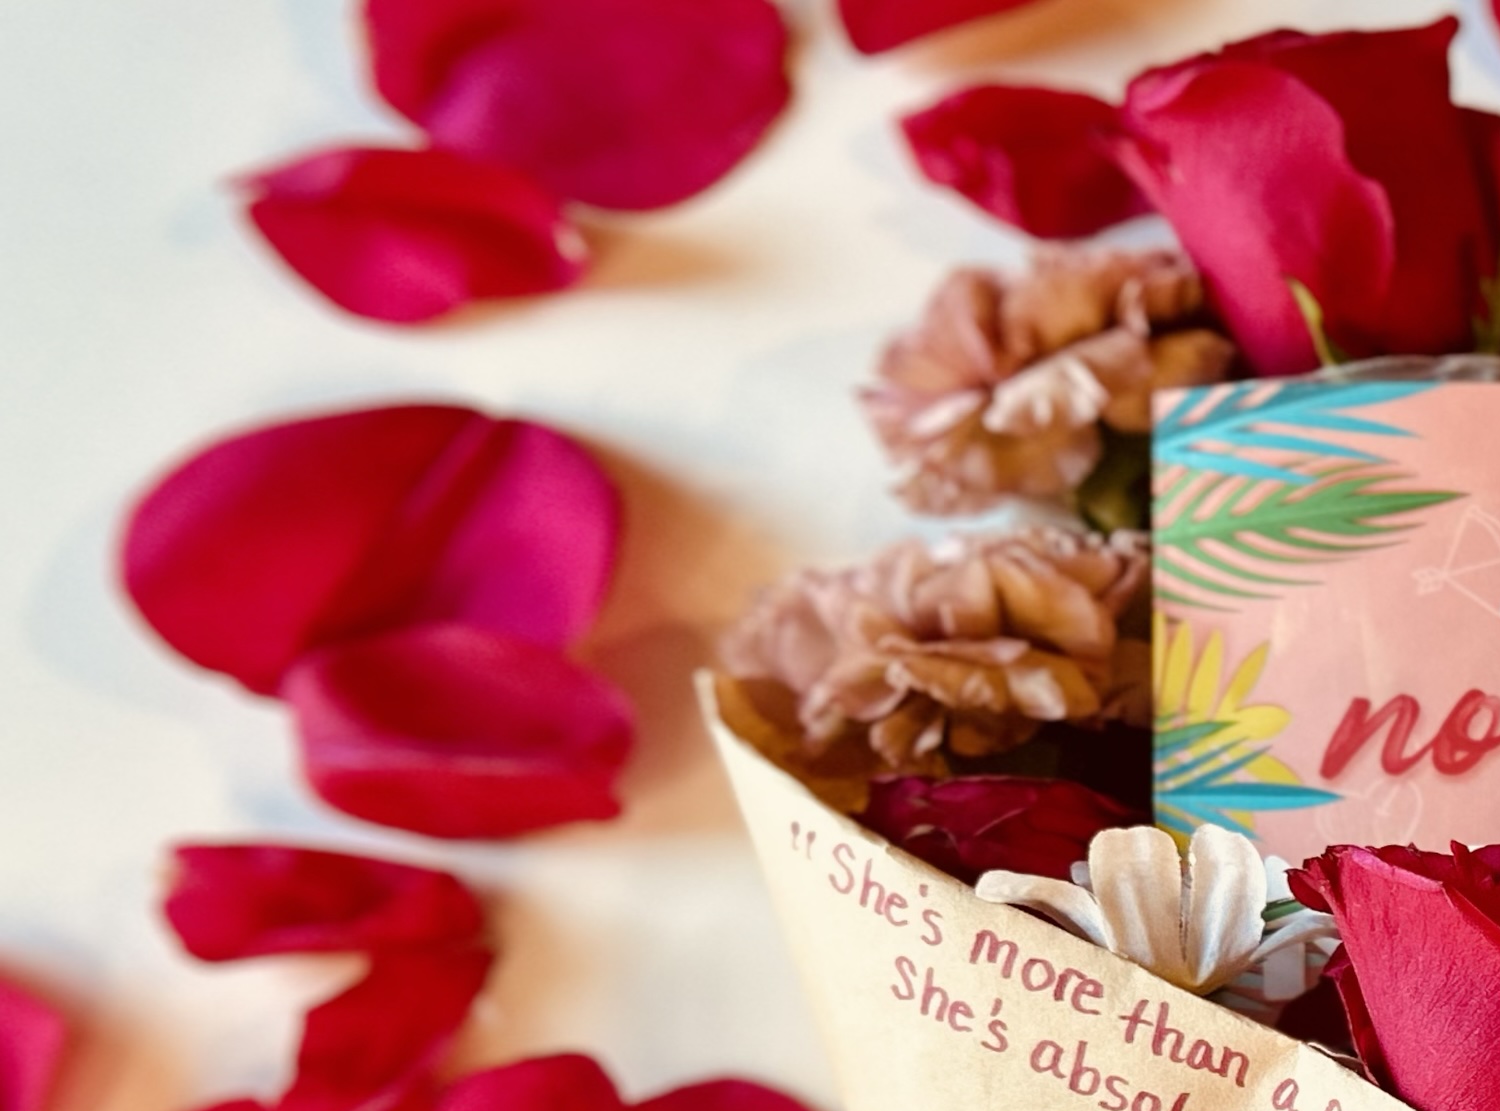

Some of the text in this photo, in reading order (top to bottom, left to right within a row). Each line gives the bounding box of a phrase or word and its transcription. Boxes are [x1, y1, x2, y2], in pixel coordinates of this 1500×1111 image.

[891, 956, 1009, 1053] She's
[969, 929, 1104, 1016] more
[1119, 1000, 1251, 1087] than
